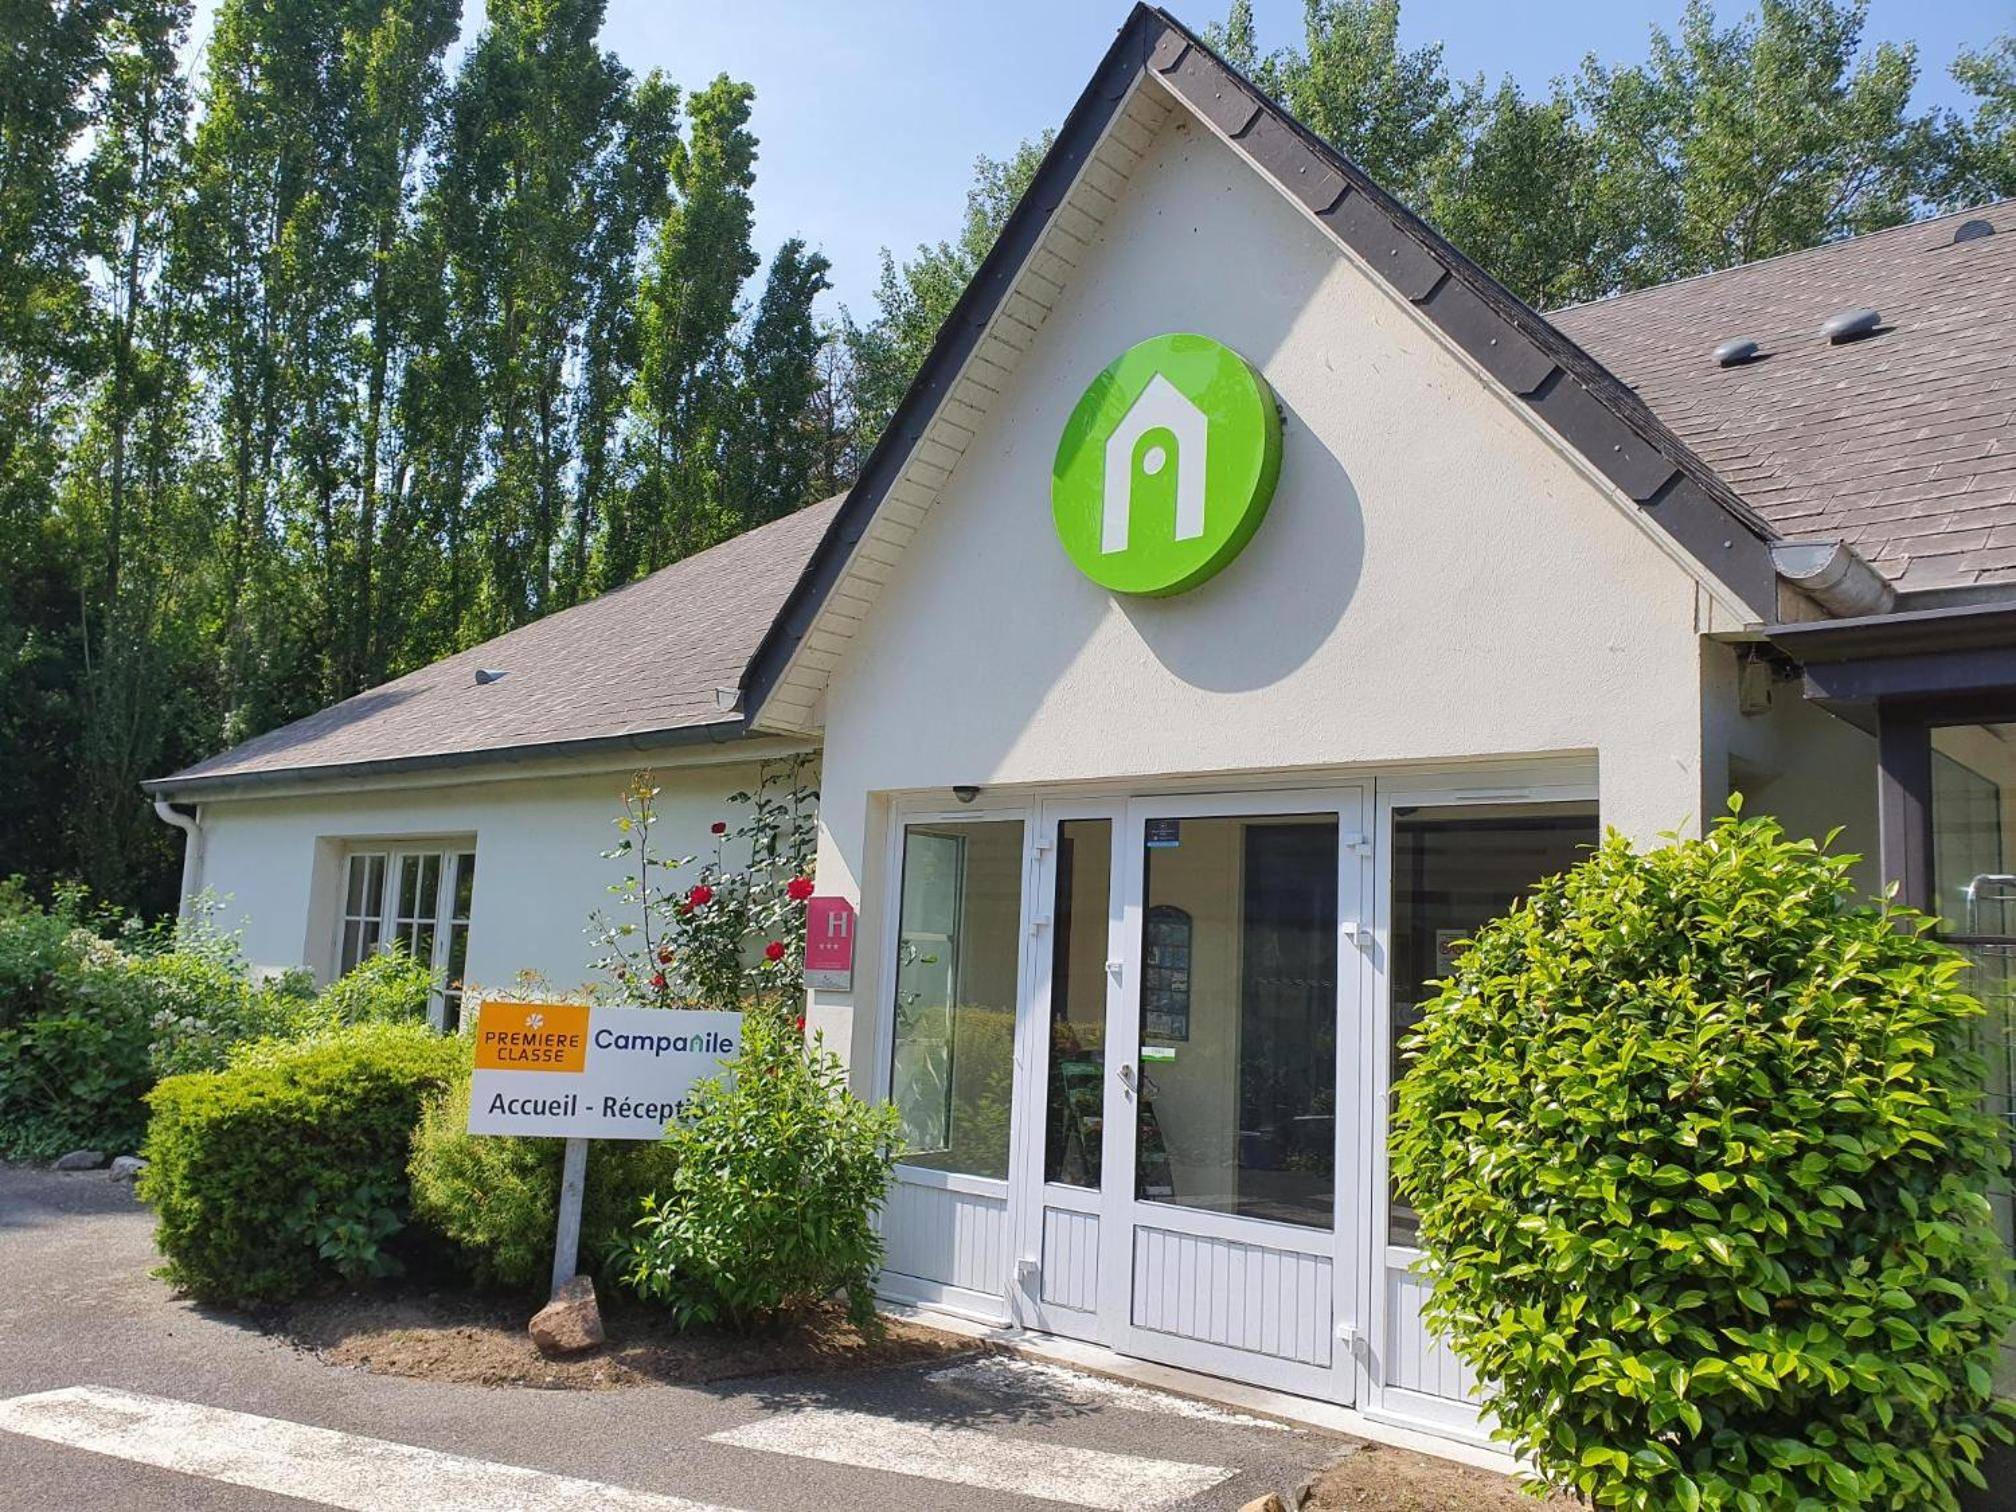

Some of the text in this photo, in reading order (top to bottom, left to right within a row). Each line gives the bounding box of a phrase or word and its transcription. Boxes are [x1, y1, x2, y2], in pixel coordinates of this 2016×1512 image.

[827, 911, 848, 938] H
[497, 1047, 565, 1063] CLASSE
[594, 1029, 734, 1057] Campanile
[488, 1093, 577, 1117] Accueil
